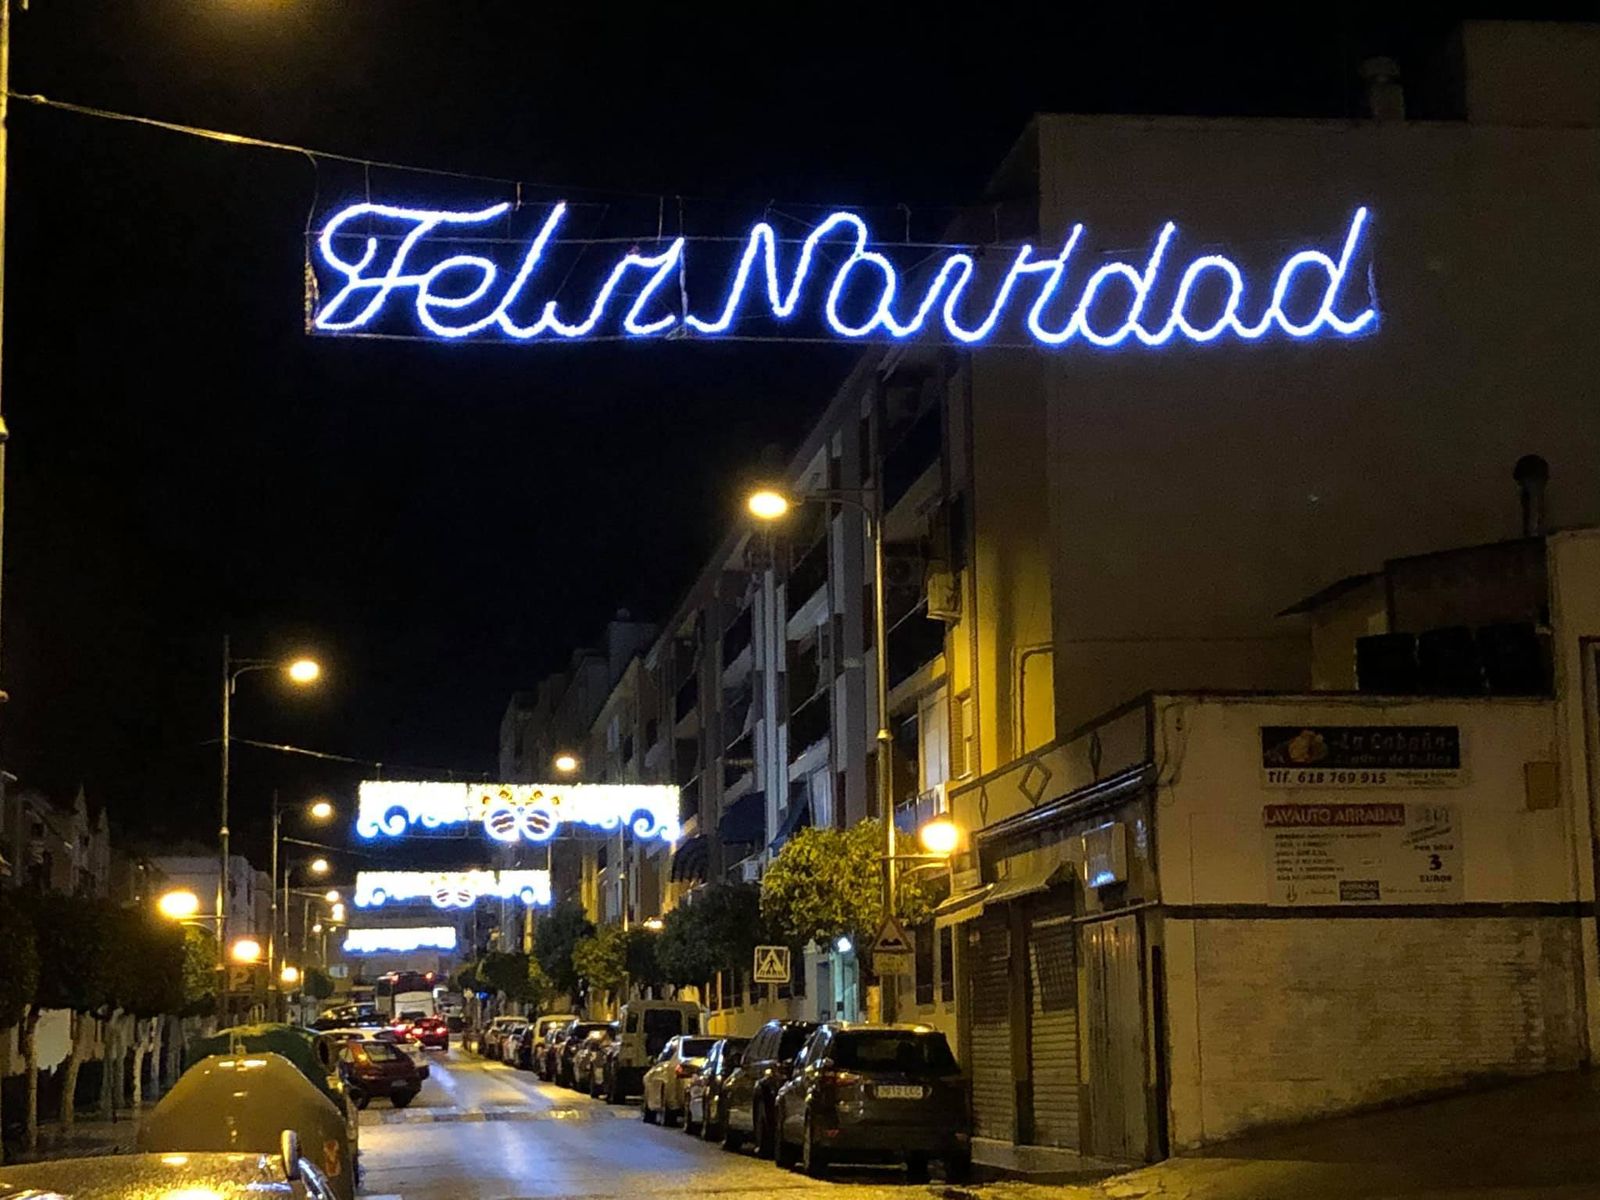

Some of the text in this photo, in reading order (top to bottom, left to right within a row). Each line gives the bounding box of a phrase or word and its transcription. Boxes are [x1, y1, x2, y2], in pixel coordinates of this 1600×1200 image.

[312, 200, 1379, 348] Feliz Navidad
[1297, 771, 1324, 784] 618
[1330, 771, 1356, 784] 769
[1360, 771, 1387, 784] 915
[1264, 807, 1331, 824] LAVAUTO
[1335, 806, 1403, 822] ARRABAL
[1428, 854, 1442, 871] 3
